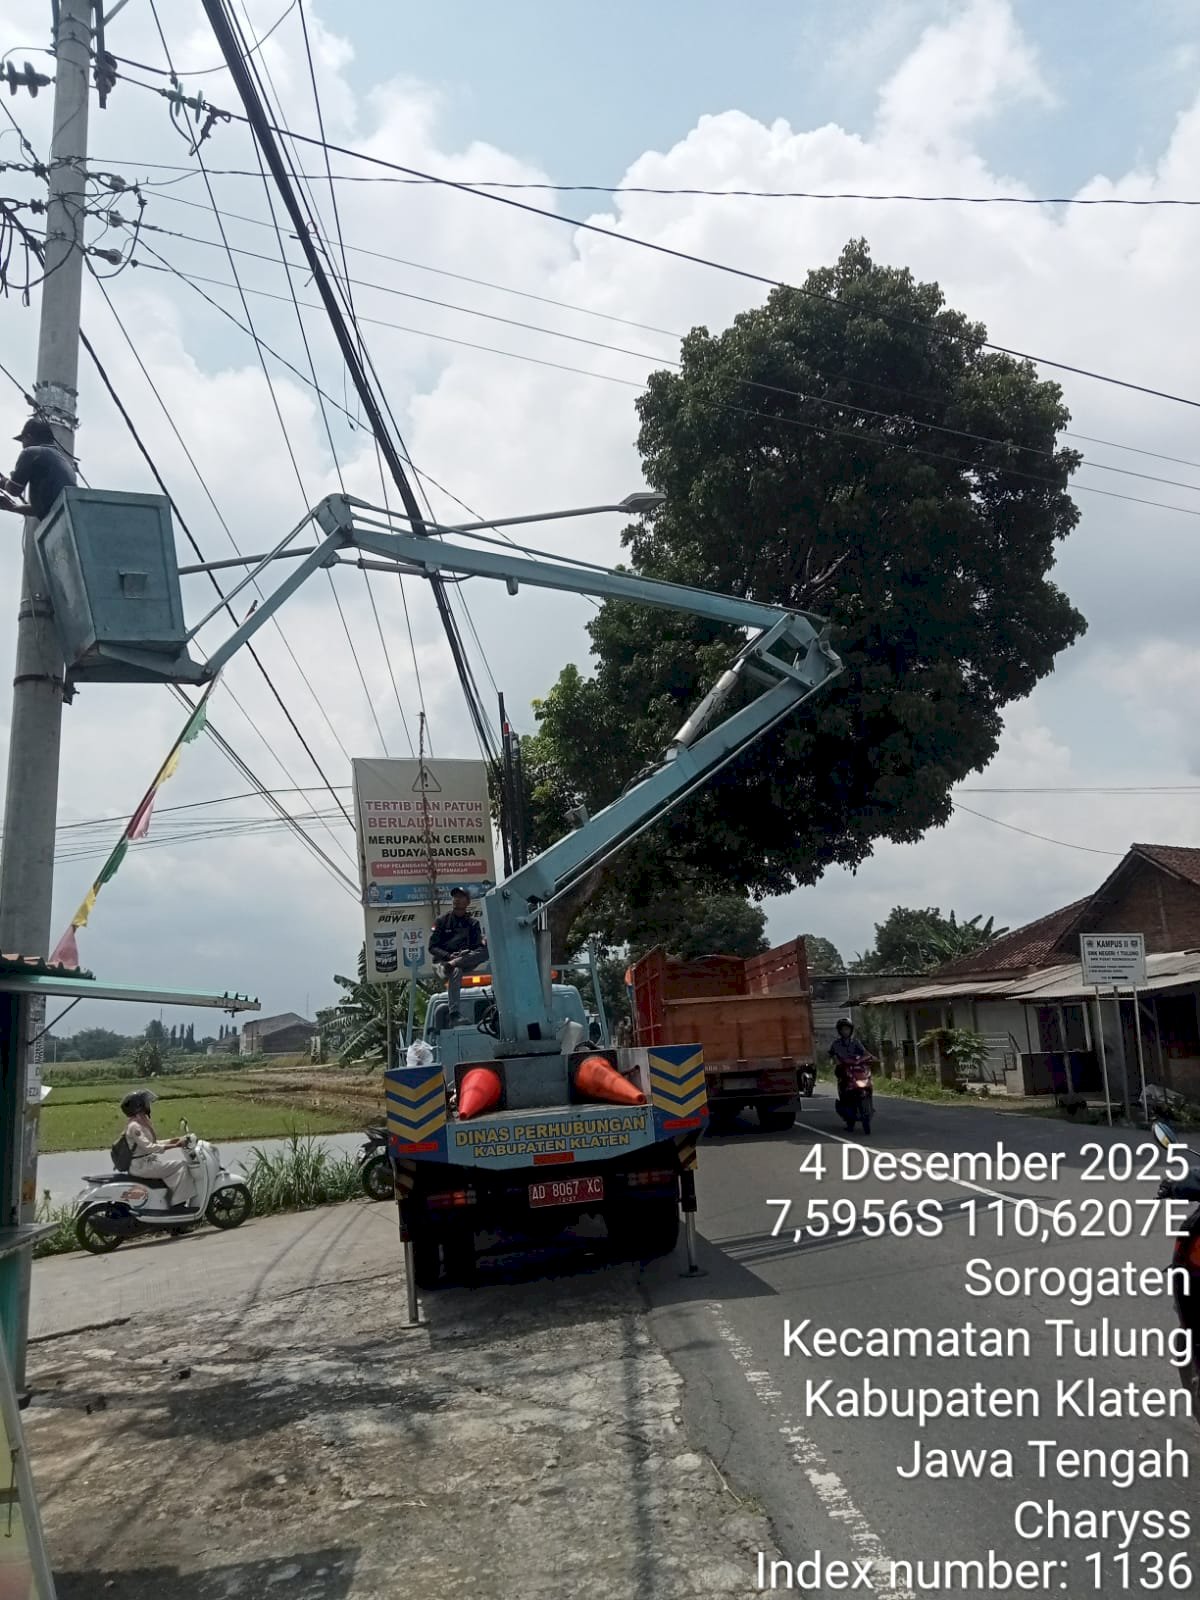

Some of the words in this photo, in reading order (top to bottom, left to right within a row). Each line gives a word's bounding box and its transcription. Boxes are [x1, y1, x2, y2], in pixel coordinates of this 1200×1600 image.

[365, 801, 412, 811] TERTIB
[416, 801, 440, 811] DAN
[444, 801, 482, 811] PATUH
[444, 834, 485, 844] CERMIN
[382, 848, 427, 858] BUDAYA
[431, 847, 476, 857] BANGSA
[378, 913, 416, 924] POWER
[403, 930, 423, 940] ABC
[376, 938, 395, 947] ABC
[1096, 940, 1123, 948] KAMPUS
[456, 1127, 509, 1146] DINAS
[514, 1116, 646, 1140] PERHUBUNGAN
[474, 1140, 566, 1158] KABUPATEN
[570, 1133, 630, 1149] KLATEN
[532, 1185, 546, 1200] AD
[552, 1181, 579, 1197] 8067
[586, 1178, 601, 1193] XC
